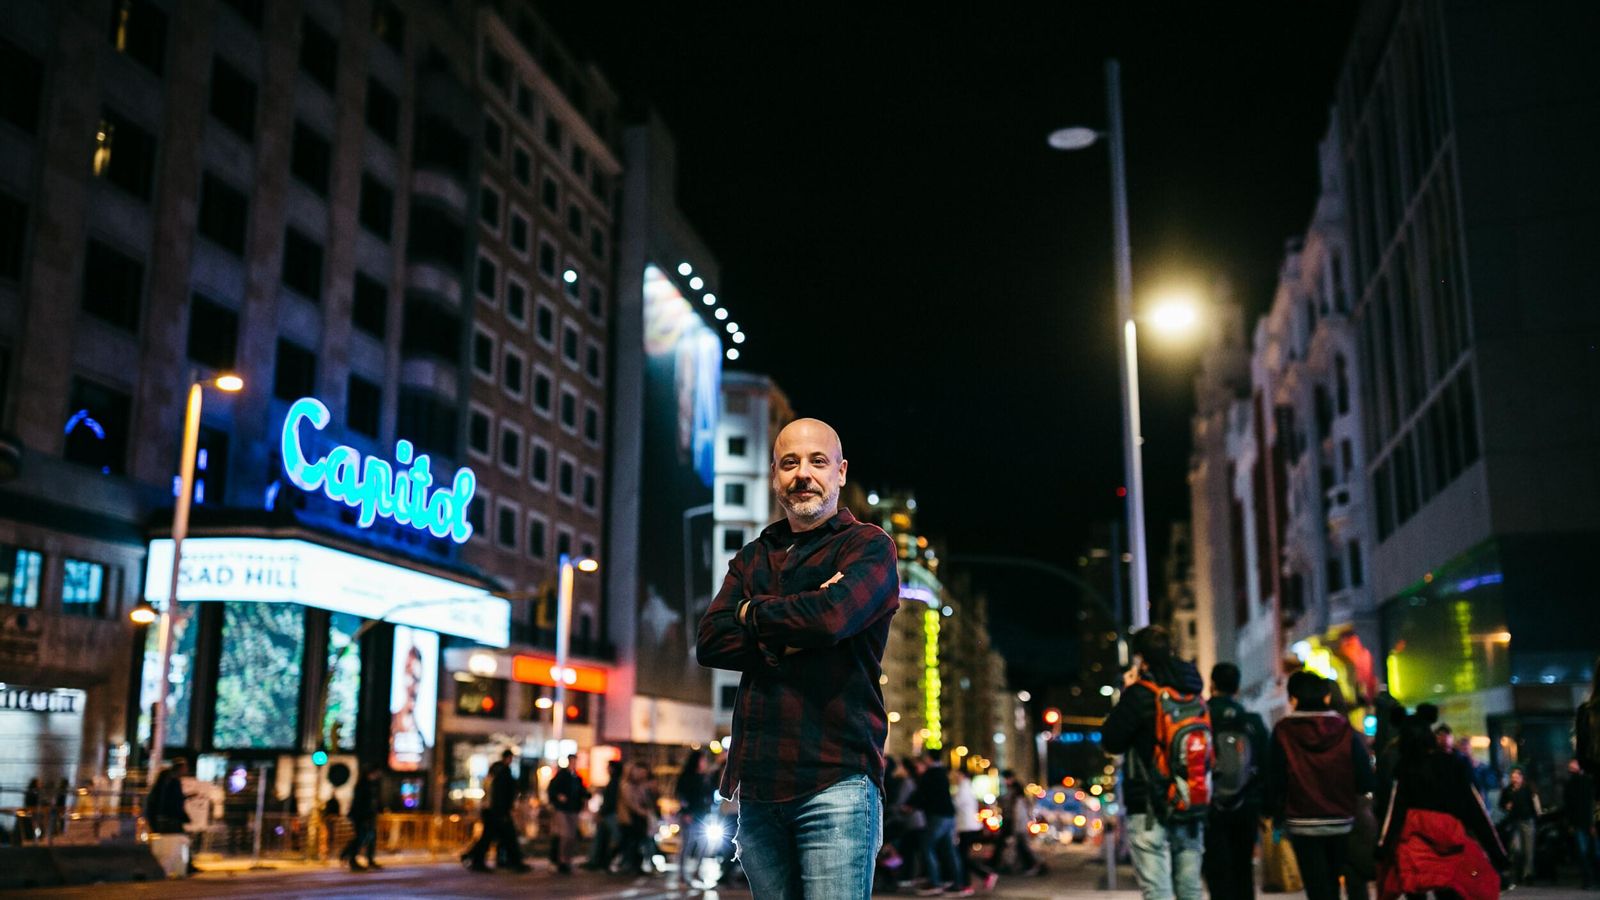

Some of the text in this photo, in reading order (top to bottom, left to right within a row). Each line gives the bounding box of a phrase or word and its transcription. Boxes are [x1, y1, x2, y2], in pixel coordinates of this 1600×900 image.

[282, 397, 476, 544] Capitol
[179, 566, 298, 588] SAD HILL
